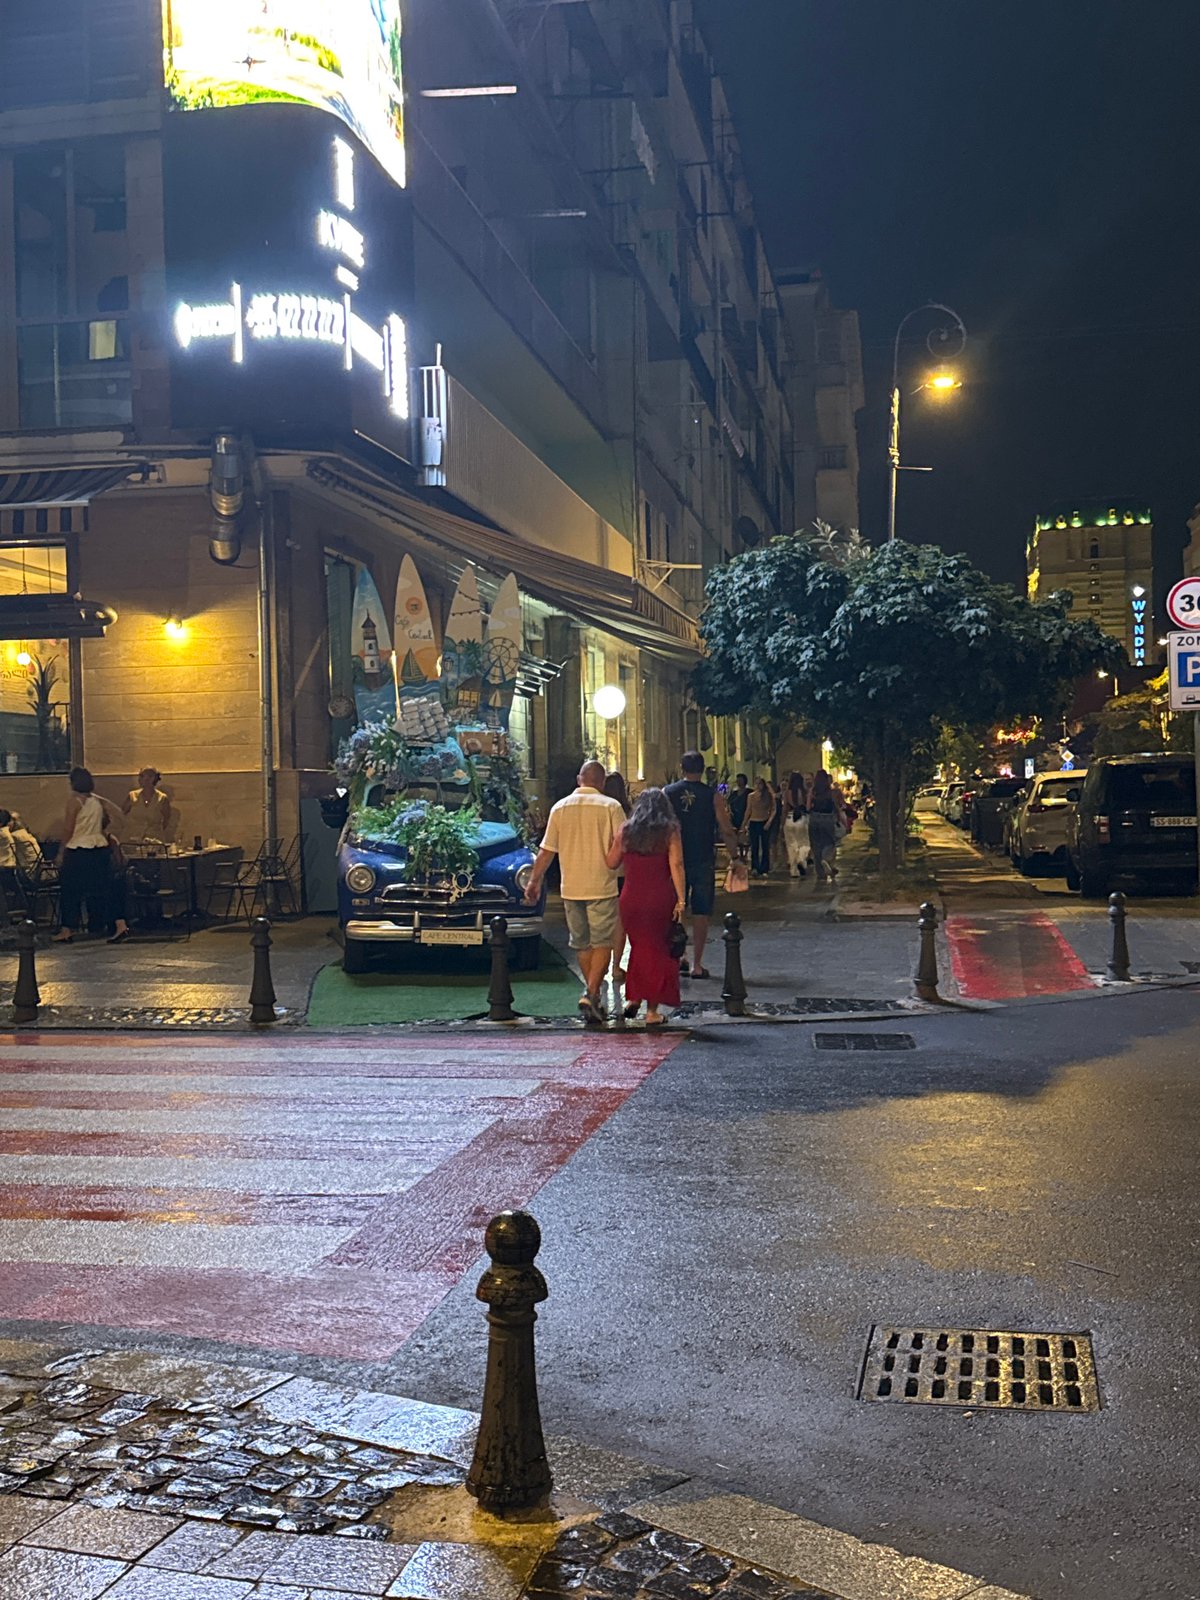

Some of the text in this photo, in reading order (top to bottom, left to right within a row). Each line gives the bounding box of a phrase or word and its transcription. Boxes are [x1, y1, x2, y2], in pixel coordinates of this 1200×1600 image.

[1179, 594, 1200, 612] 3
[1177, 636, 1200, 647] ZO
[443, 932, 475, 940] CENTRAL
